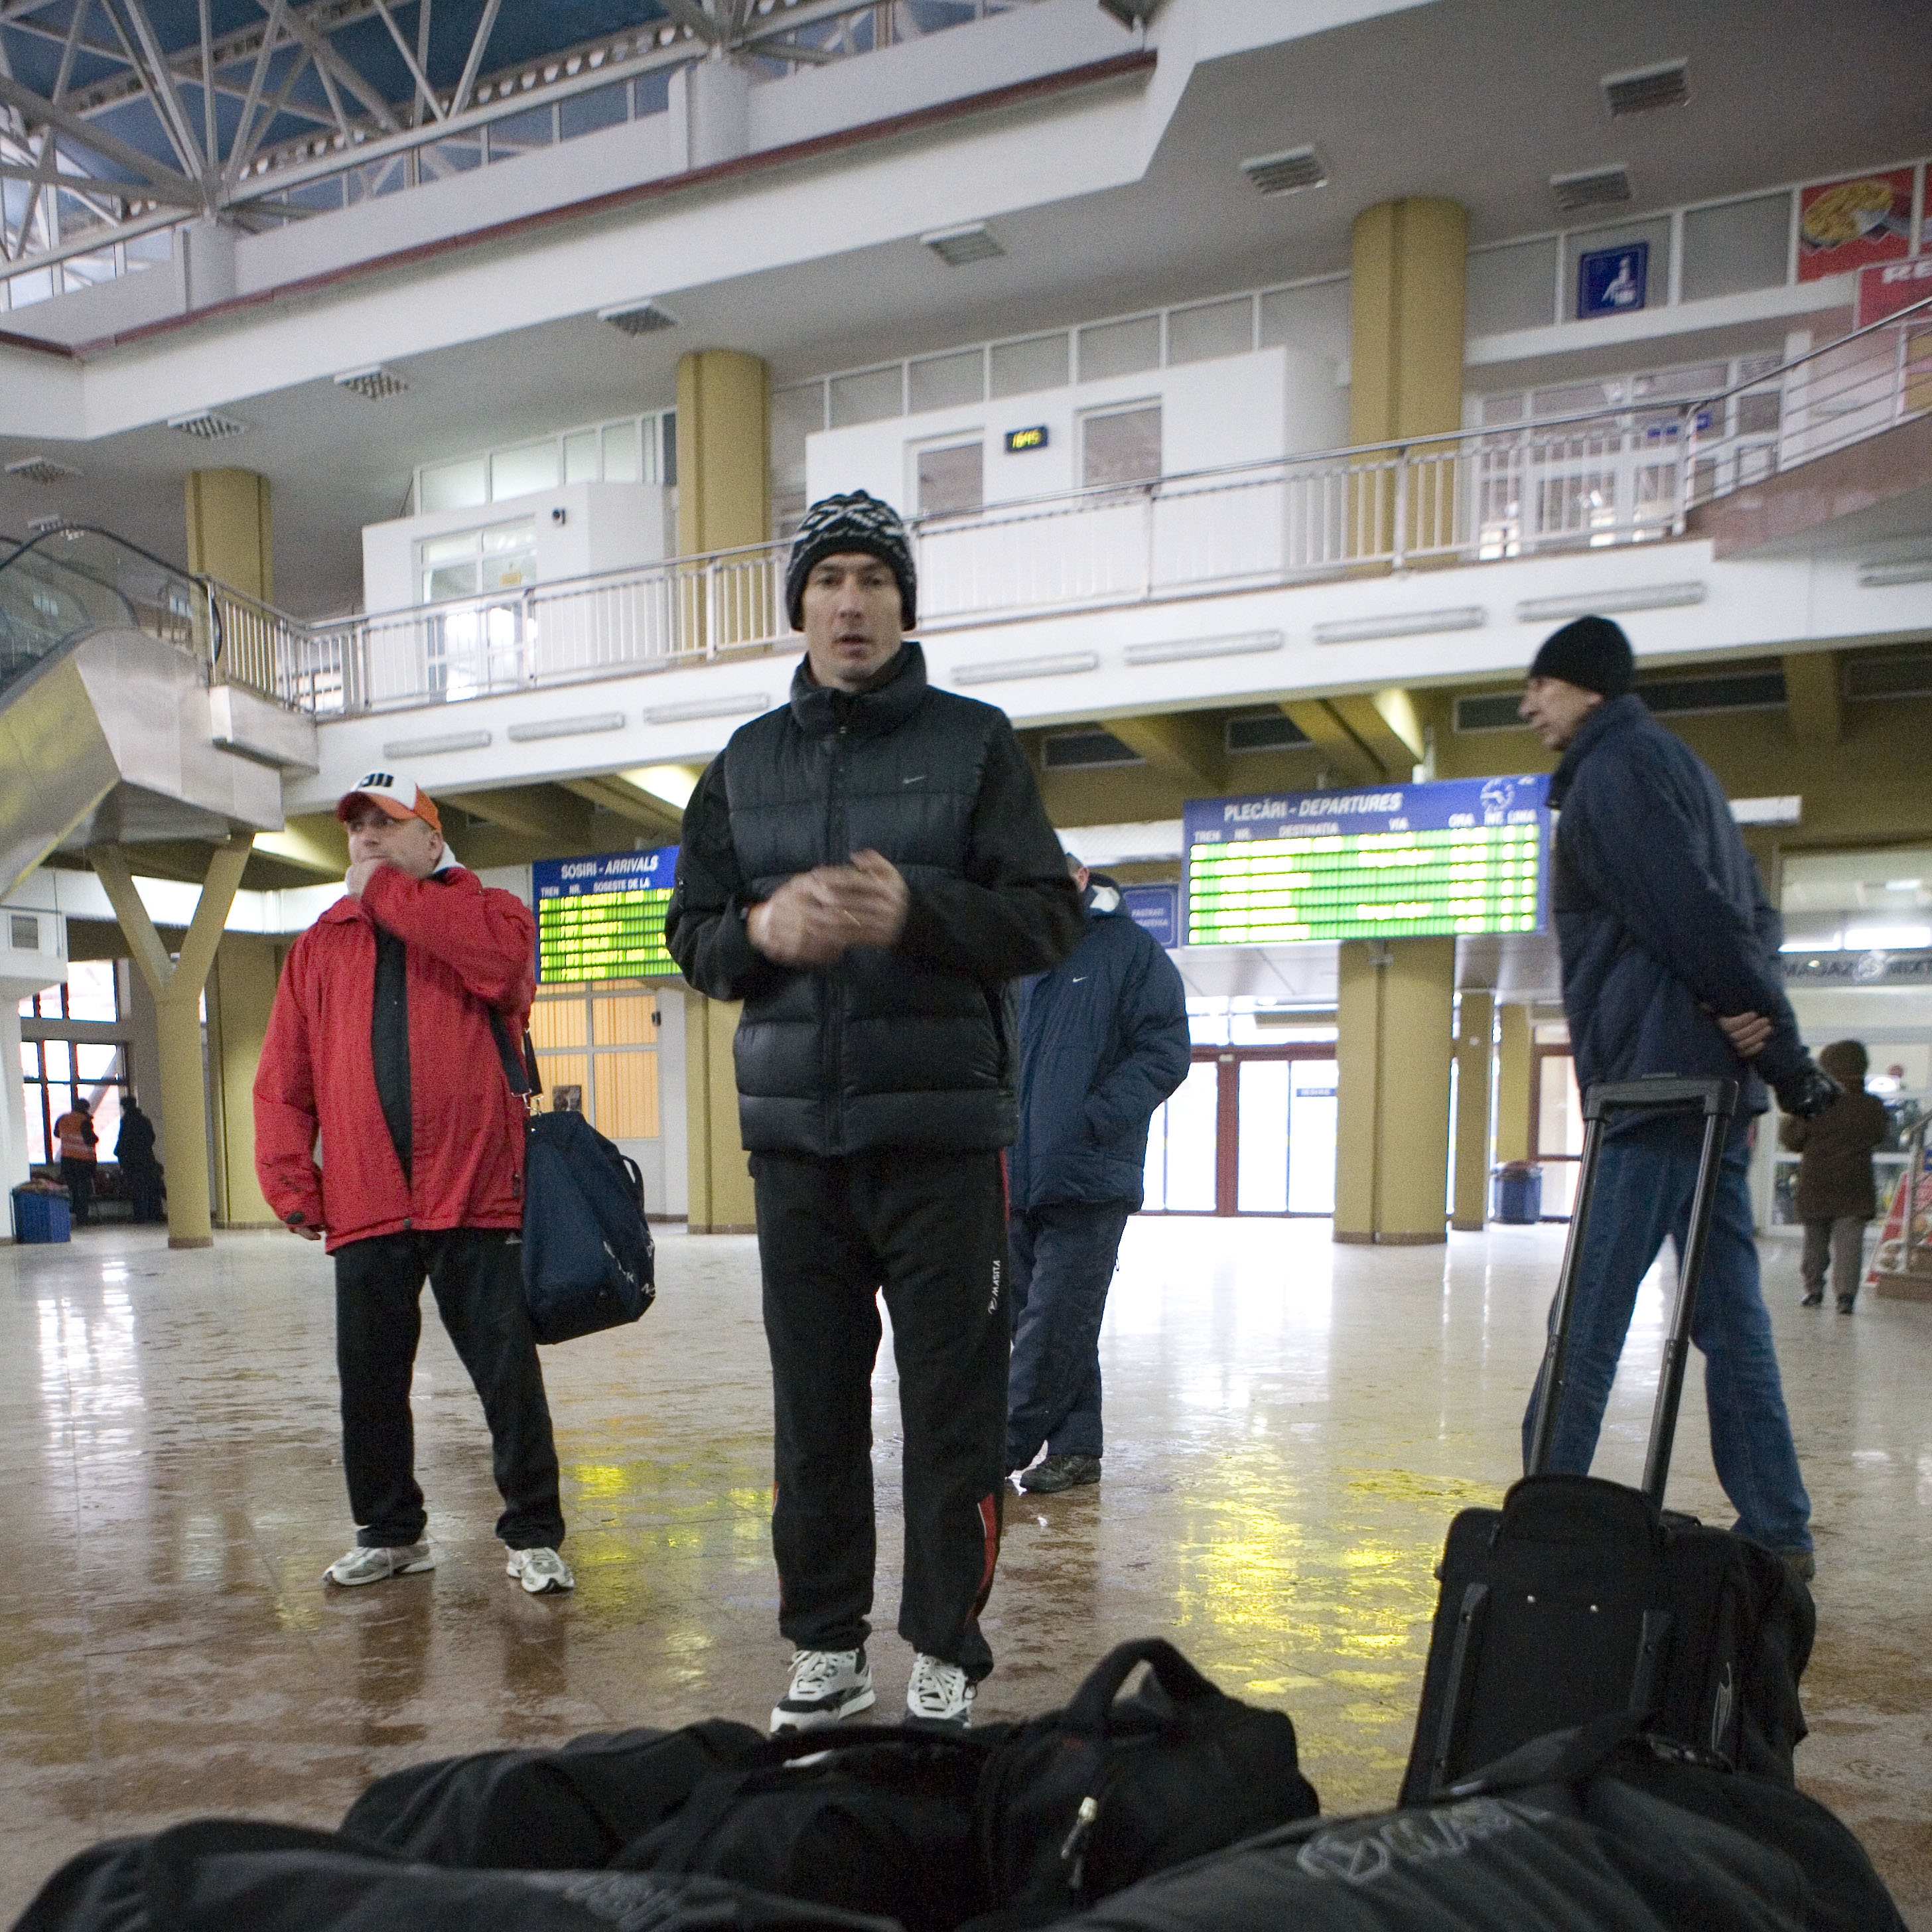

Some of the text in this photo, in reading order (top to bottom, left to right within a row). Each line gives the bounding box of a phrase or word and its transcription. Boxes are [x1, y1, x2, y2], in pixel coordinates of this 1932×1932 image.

[1298, 792, 1404, 817] DEPARTURES
[561, 862, 596, 879] SOSIRI
[604, 855, 659, 875] ARRIVALS
[628, 878, 639, 890] DE
[640, 876, 650, 888] LA
